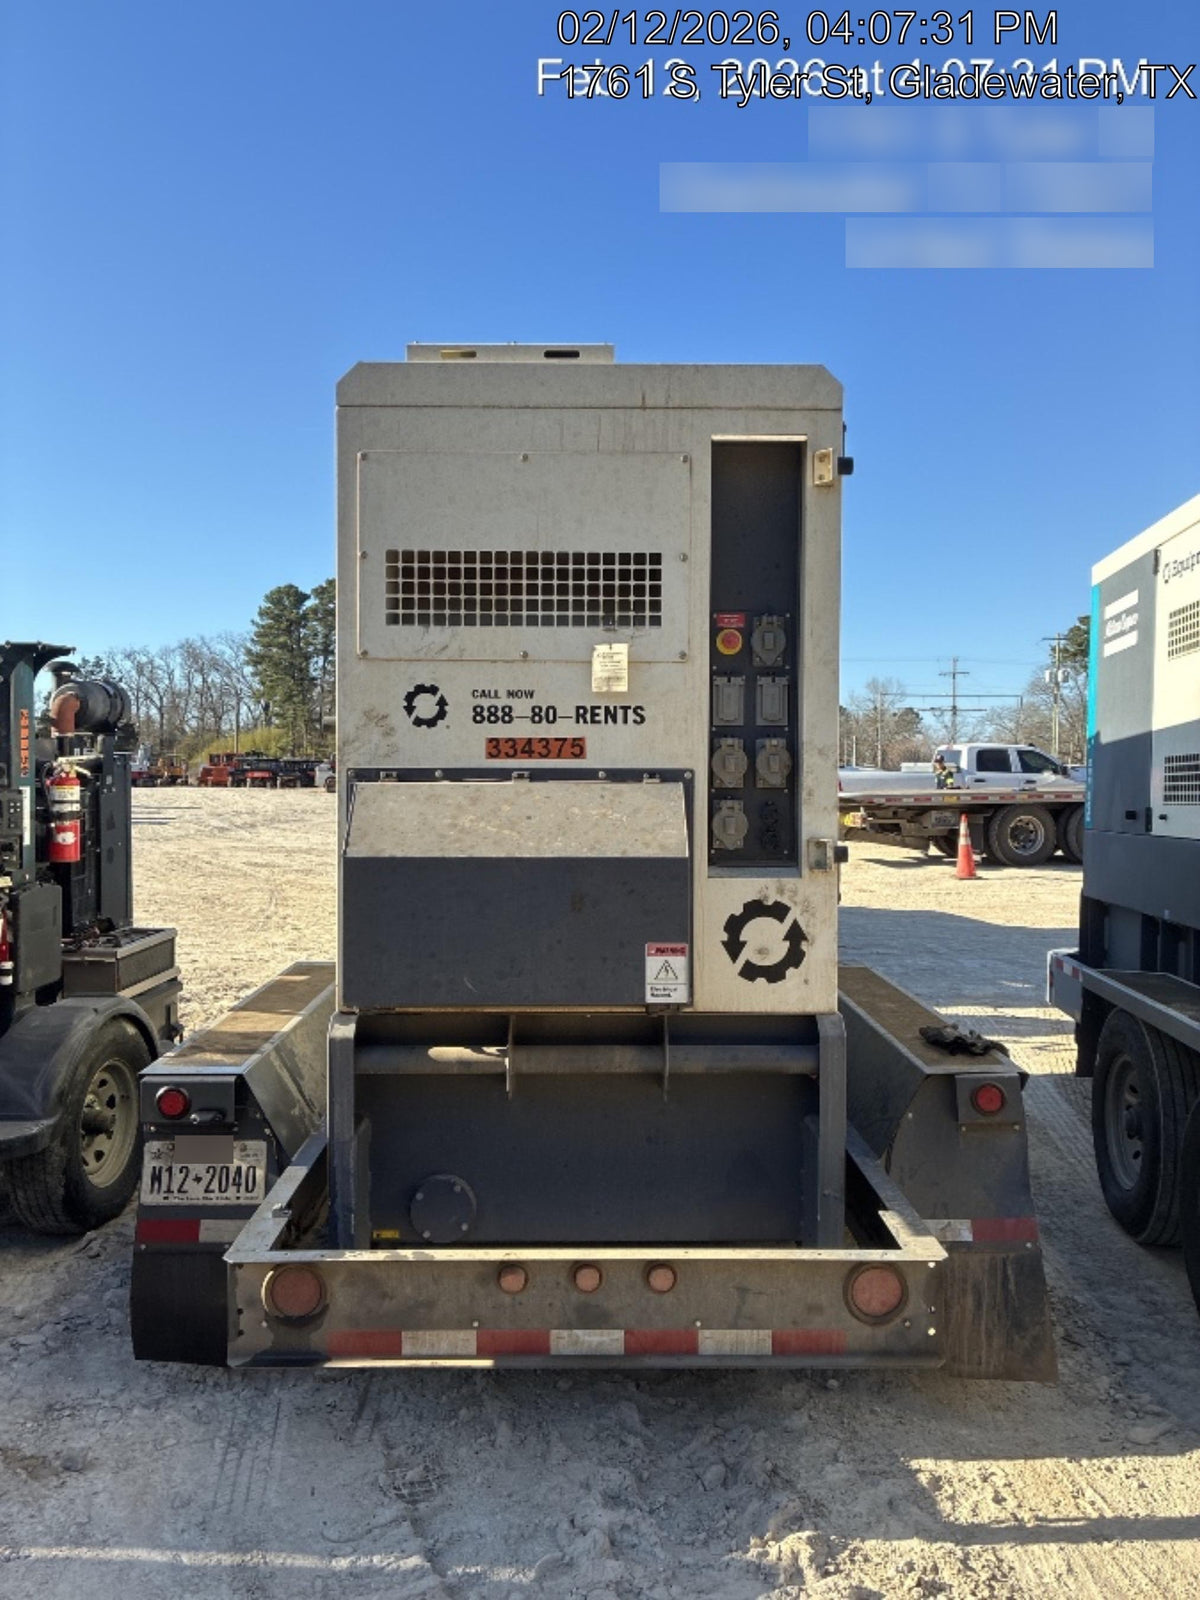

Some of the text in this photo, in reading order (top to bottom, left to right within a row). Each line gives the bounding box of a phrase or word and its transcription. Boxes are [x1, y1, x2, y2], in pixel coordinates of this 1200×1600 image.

[472, 689, 535, 700] CALL NOW
[487, 737, 585, 759] 334375
